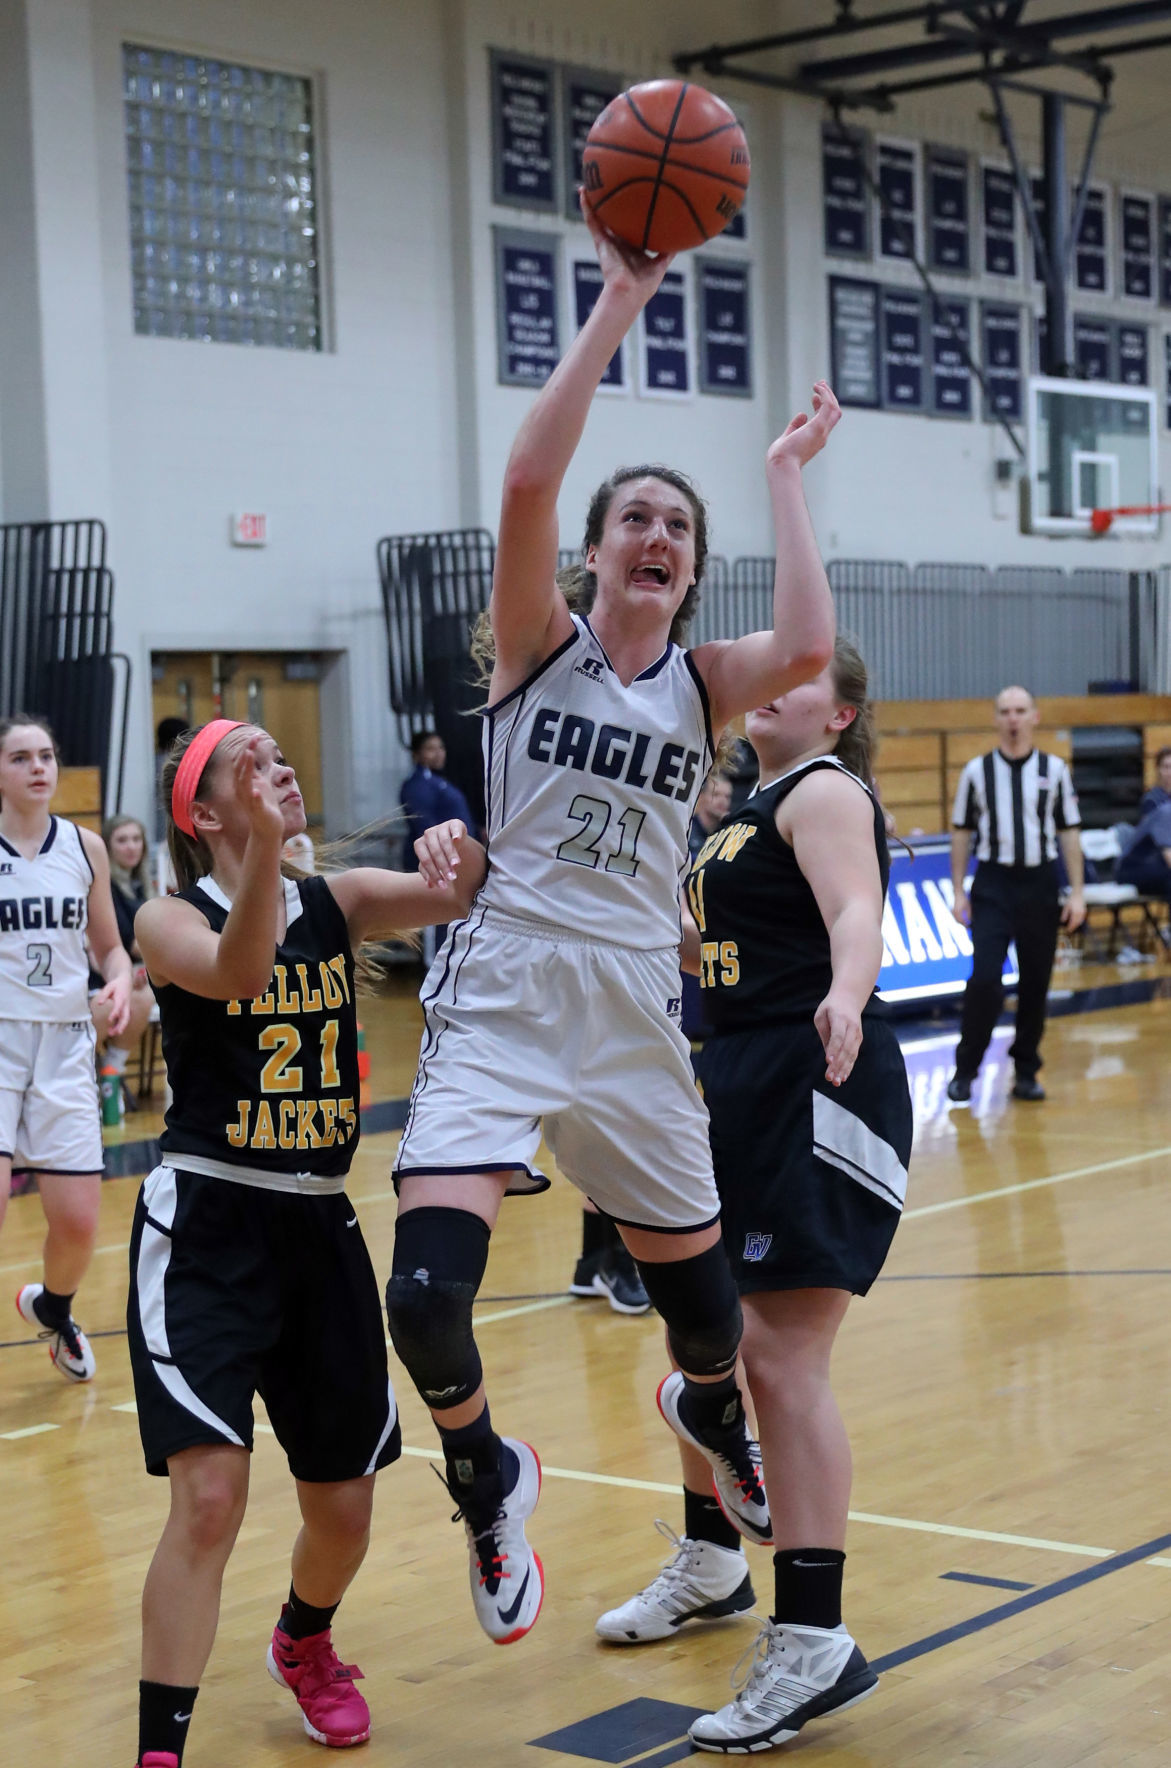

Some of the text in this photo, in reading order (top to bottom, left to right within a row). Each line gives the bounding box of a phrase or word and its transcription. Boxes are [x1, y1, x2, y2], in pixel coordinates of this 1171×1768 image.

[574, 666, 605, 684] RUSSELL
[527, 708, 701, 803] EAGLES
[556, 793, 648, 878] 21
[26, 943, 52, 987] 2
[258, 1019, 342, 1094] 21
